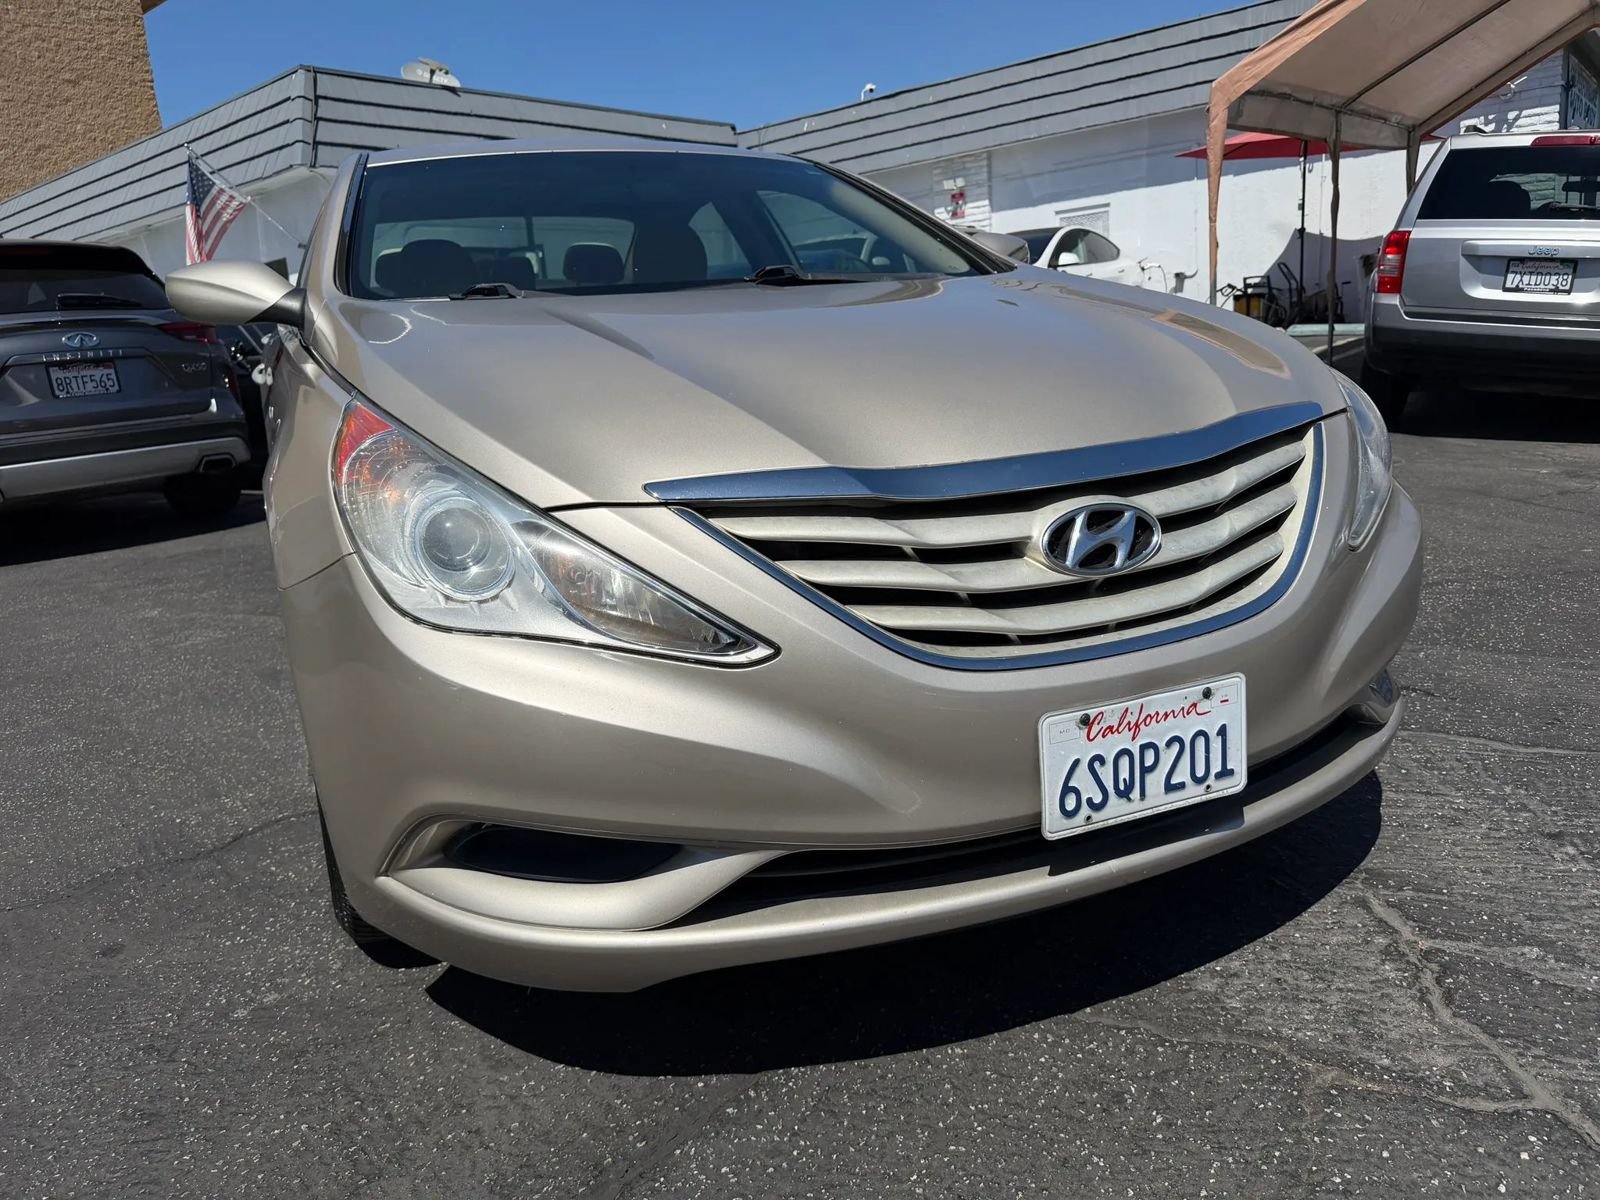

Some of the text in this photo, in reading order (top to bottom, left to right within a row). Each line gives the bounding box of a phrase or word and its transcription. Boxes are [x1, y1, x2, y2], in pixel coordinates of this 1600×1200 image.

[1528, 245, 1559, 256] Jeep
[1510, 271, 1570, 288] 7XID038
[55, 373, 116, 393] 8RTF565
[1086, 699, 1211, 743] California
[1058, 723, 1235, 818] 6SQP201
